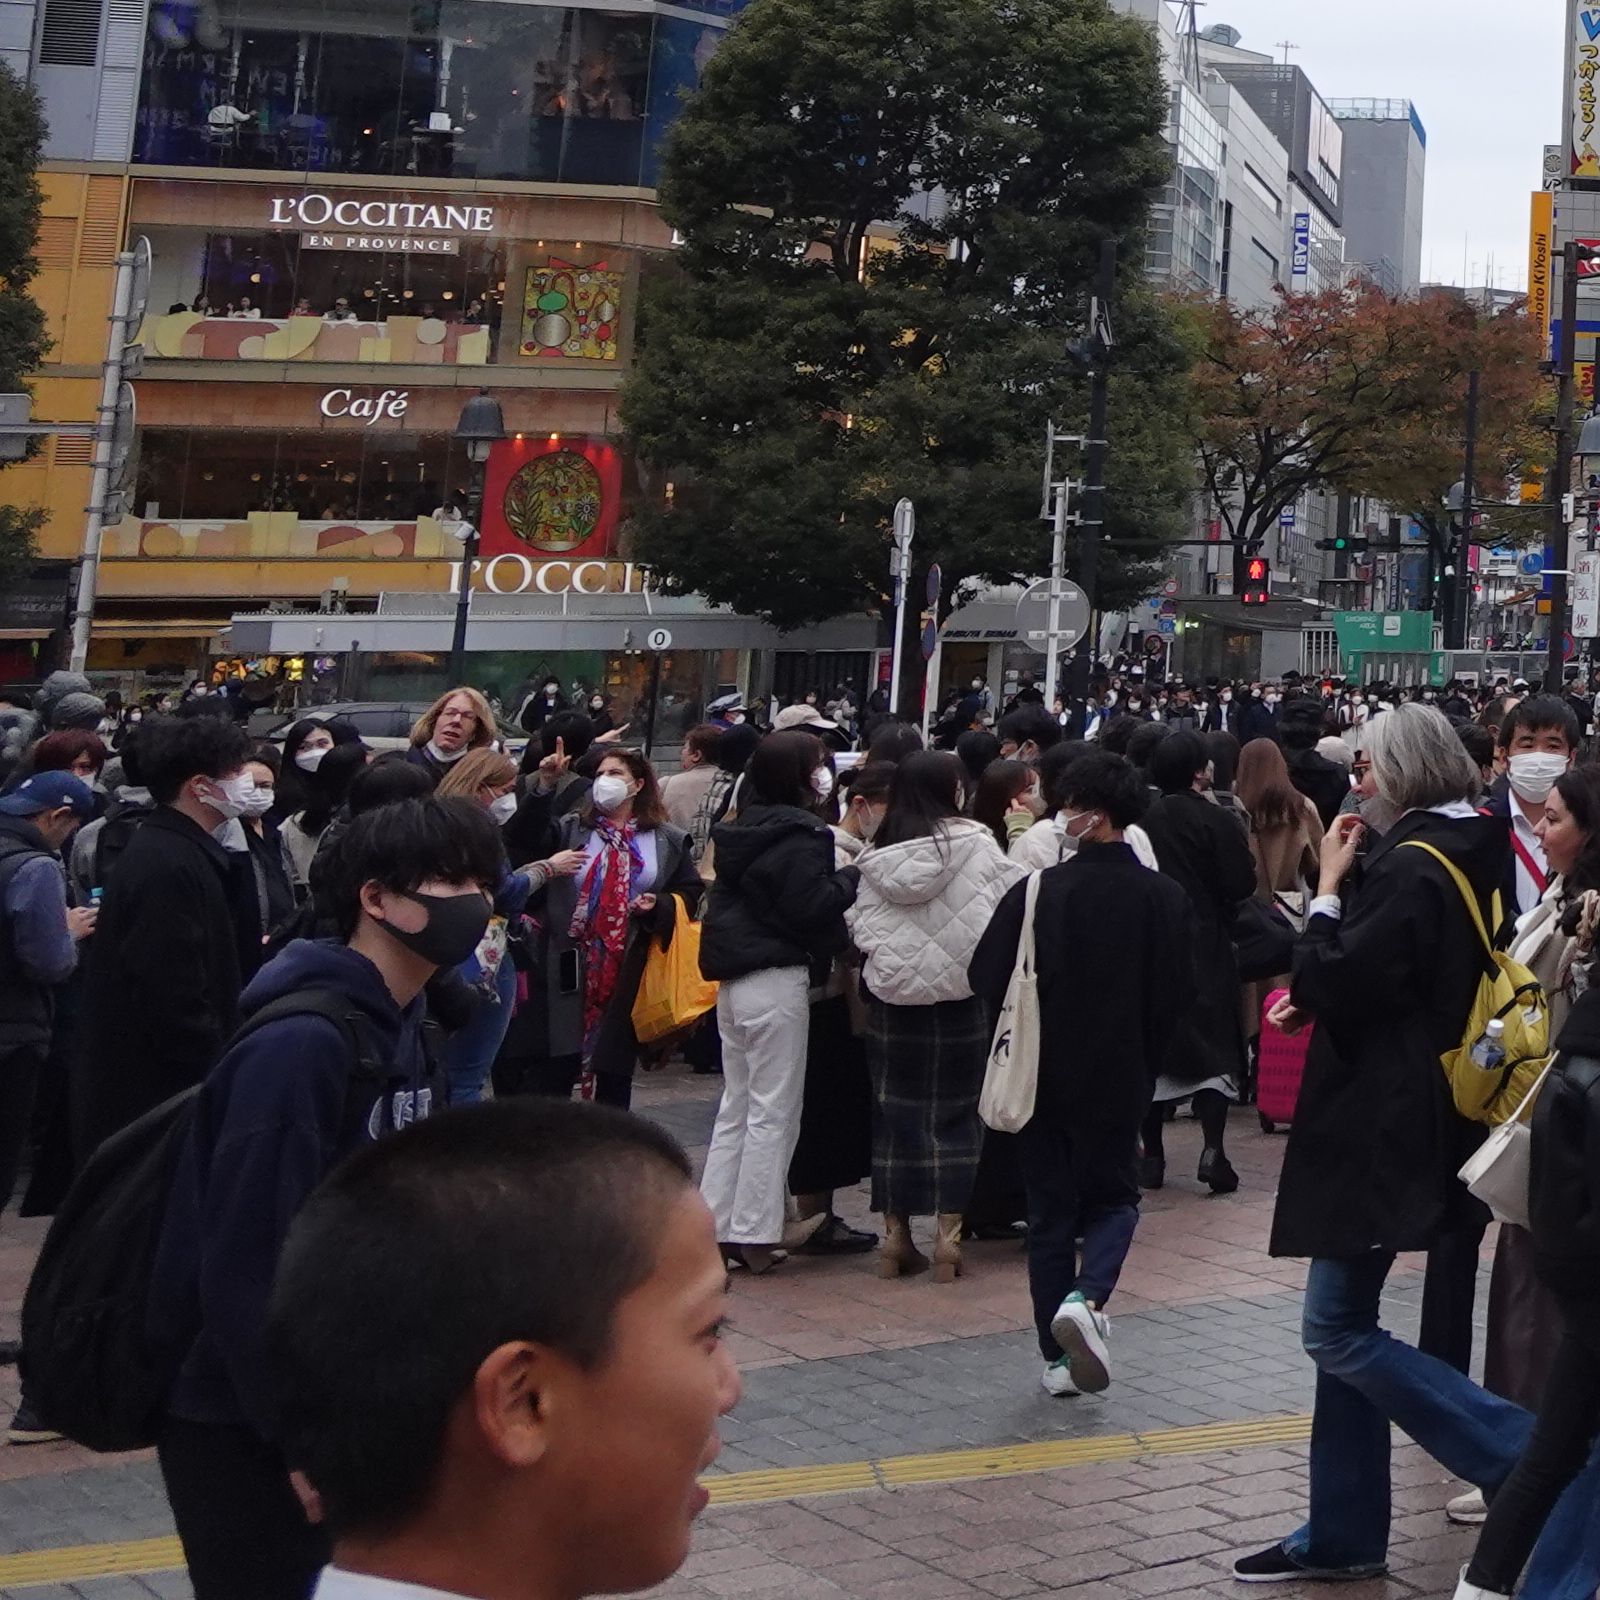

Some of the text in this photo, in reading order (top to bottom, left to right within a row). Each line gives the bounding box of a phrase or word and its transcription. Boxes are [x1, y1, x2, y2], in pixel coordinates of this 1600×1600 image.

[270, 193, 494, 231] L'OCCITANE
[309, 235, 453, 253] EN PROVENCE
[320, 389, 408, 426] Café
[1575, 559, 1592, 628] 道玄坂
